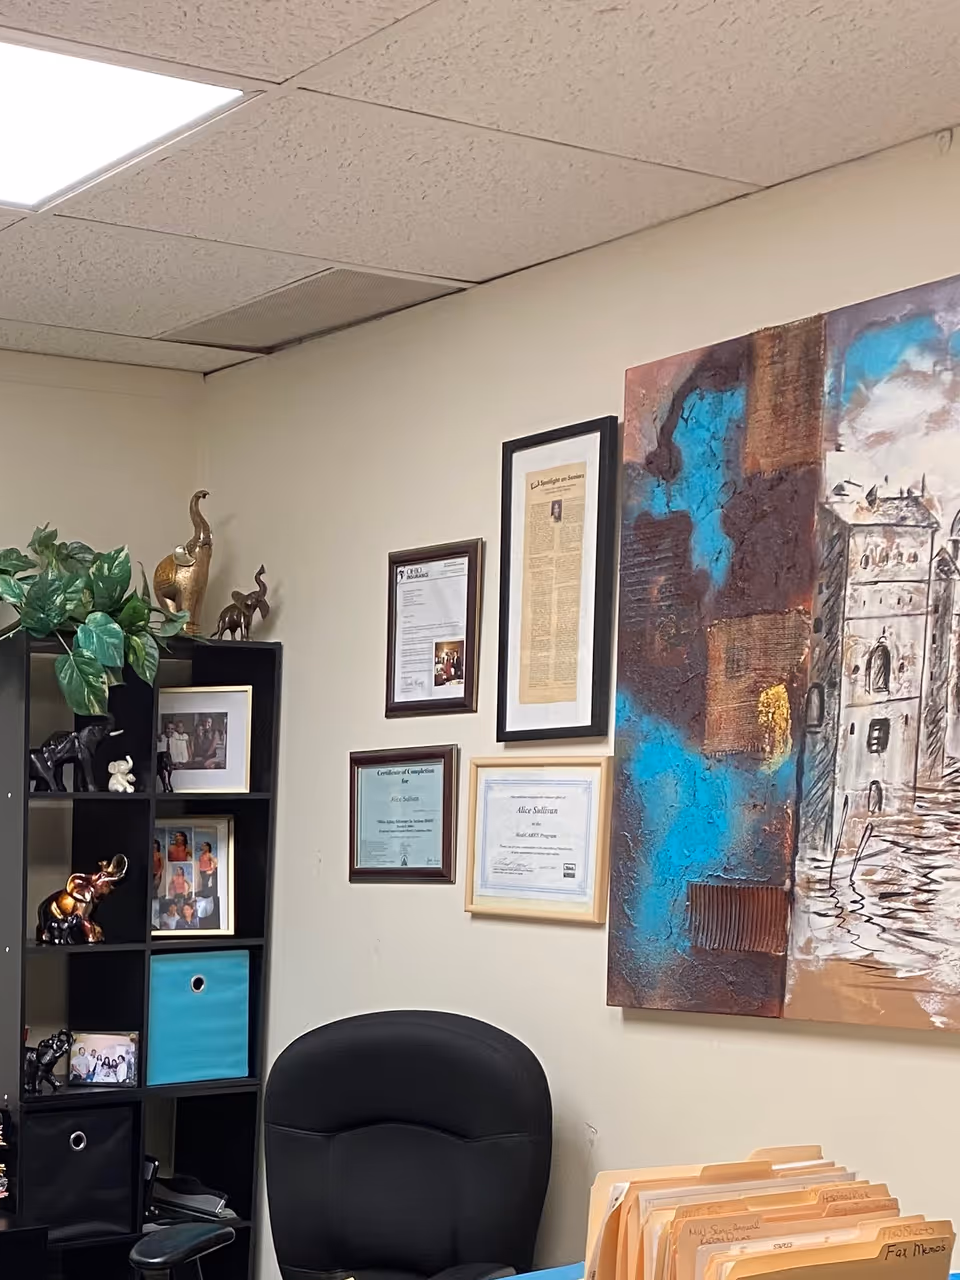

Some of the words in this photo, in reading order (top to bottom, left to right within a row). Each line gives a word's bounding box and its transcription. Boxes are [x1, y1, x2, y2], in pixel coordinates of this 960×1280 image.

[407, 767, 435, 775] Completion
[516, 806, 532, 815] Alice
[532, 806, 558, 815] Sullivan
[885, 1243, 908, 1261] Fax
[913, 1240, 946, 1257] Memo's
